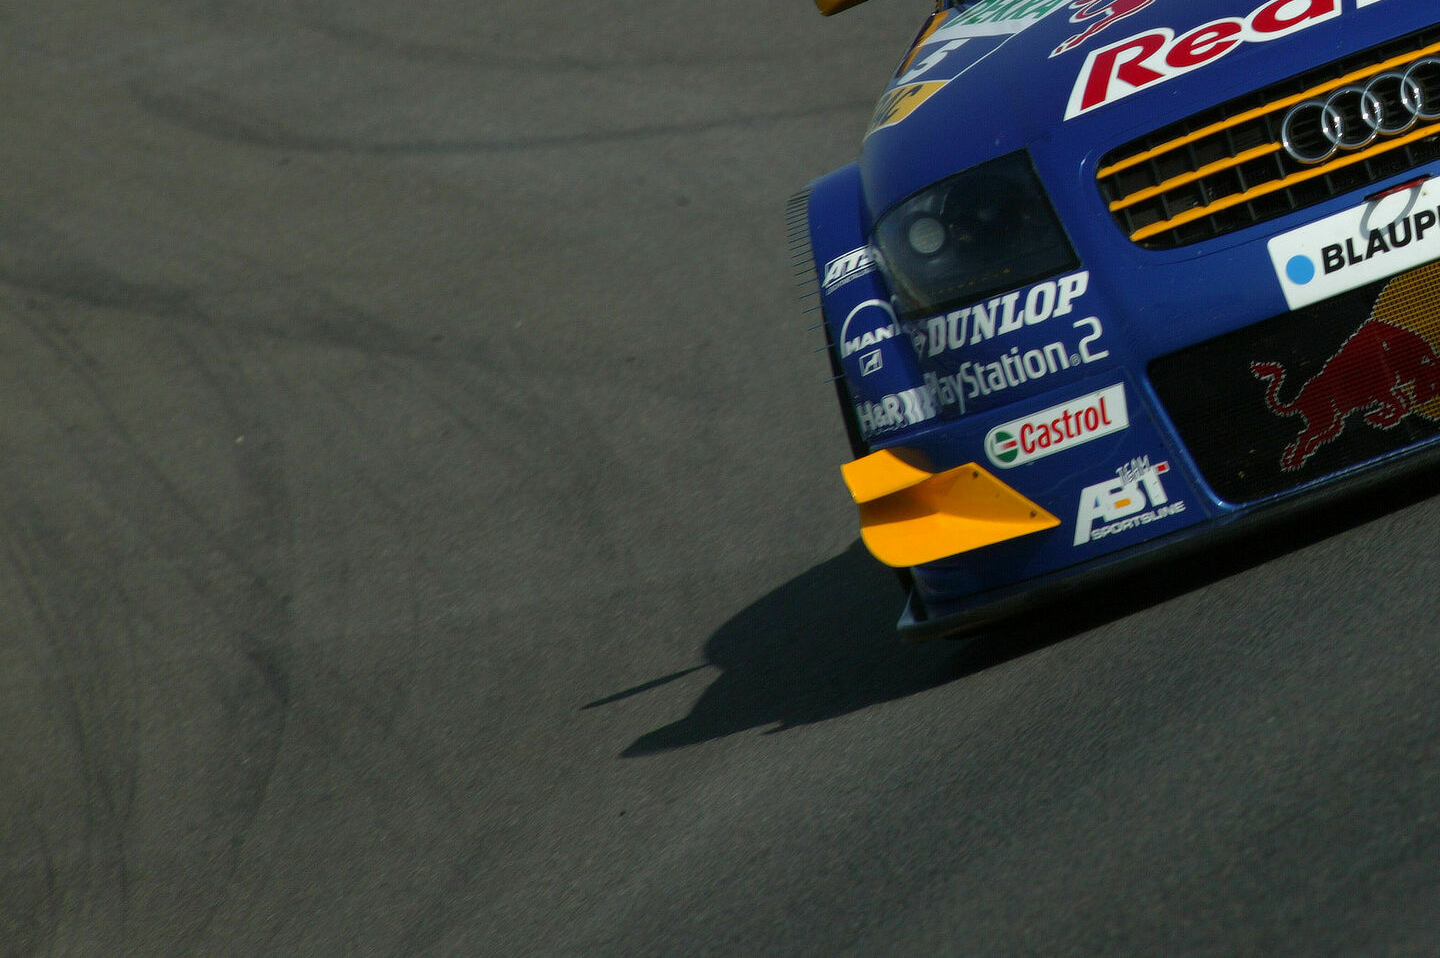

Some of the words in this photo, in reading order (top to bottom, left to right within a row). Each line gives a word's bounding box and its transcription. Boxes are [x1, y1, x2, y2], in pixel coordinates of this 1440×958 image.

[842, 324, 899, 359] MAN
[928, 271, 1090, 358] DUNLOP
[1019, 397, 1112, 454] Castrol
[1073, 460, 1170, 546] ABT
[1091, 500, 1187, 541] SPORTSLINE
